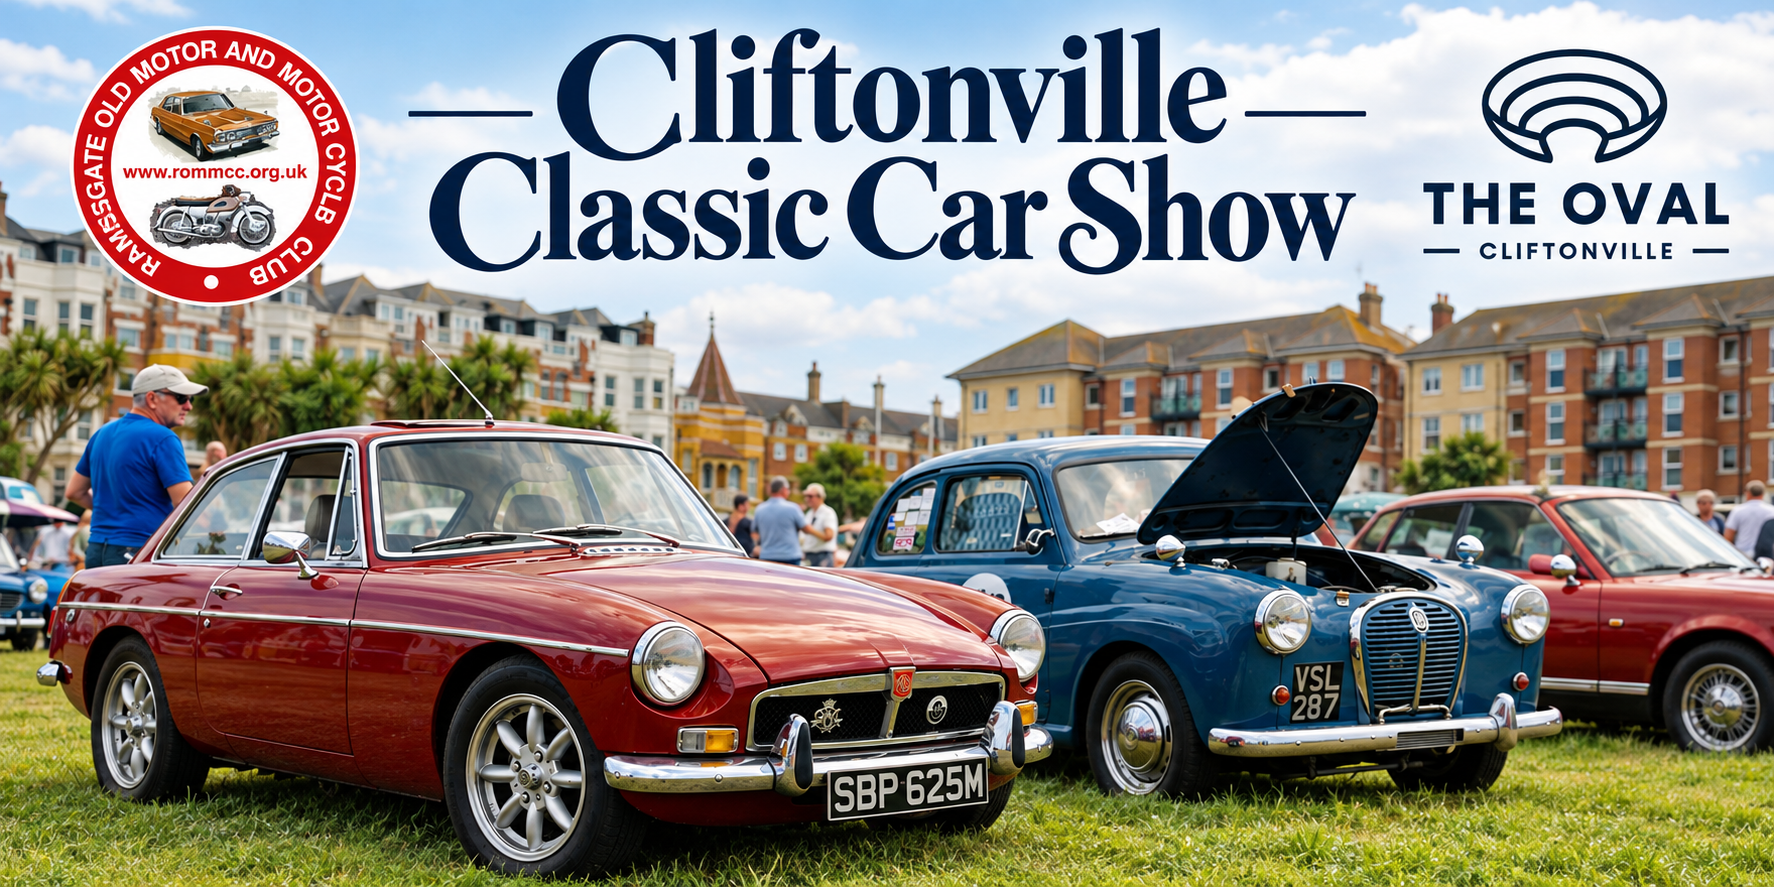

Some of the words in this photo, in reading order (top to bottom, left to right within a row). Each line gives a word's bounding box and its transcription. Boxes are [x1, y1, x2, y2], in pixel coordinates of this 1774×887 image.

[1295, 664, 1340, 693] VSL
[1292, 693, 1340, 721] 287
[834, 771, 898, 813] SBP
[906, 763, 984, 806] 625M
